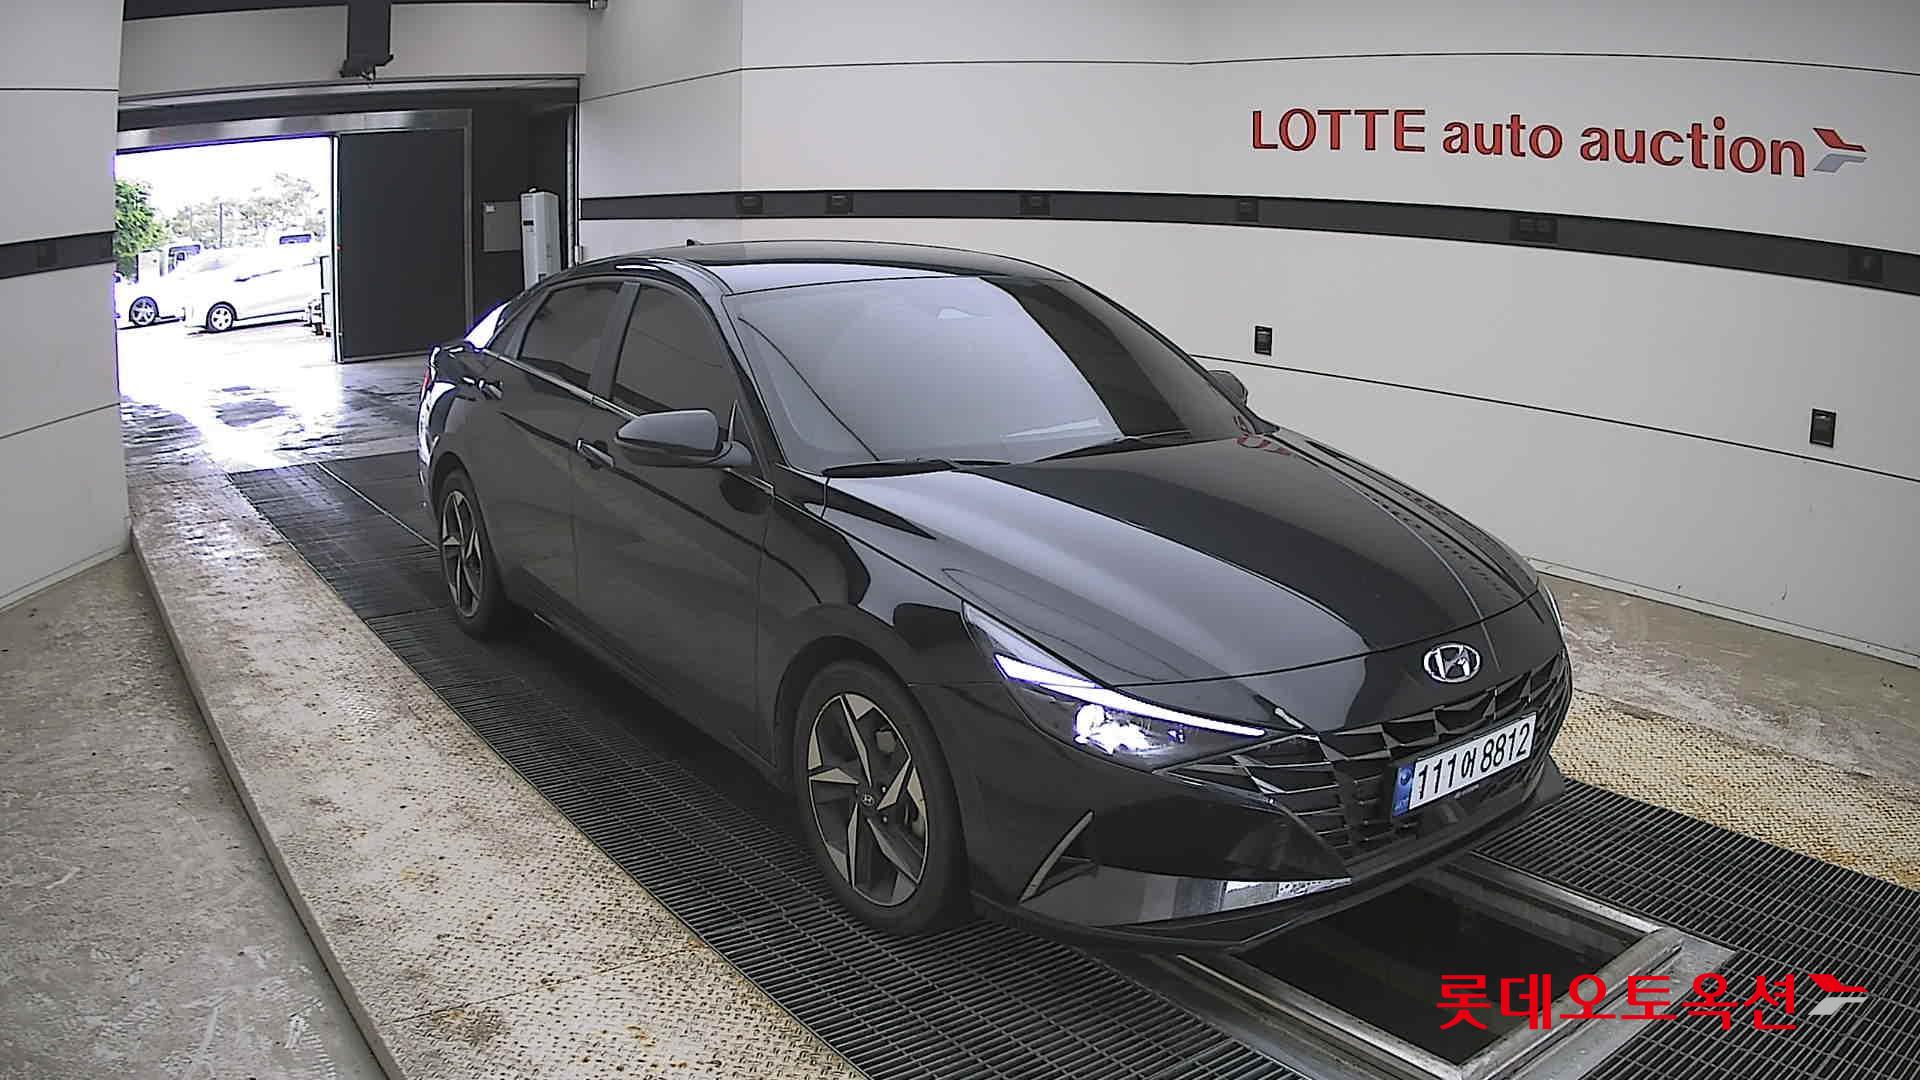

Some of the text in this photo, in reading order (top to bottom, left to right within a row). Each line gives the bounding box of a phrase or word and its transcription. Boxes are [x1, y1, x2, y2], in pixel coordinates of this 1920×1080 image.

[1252, 108, 1806, 178] LOTTE auto auction
